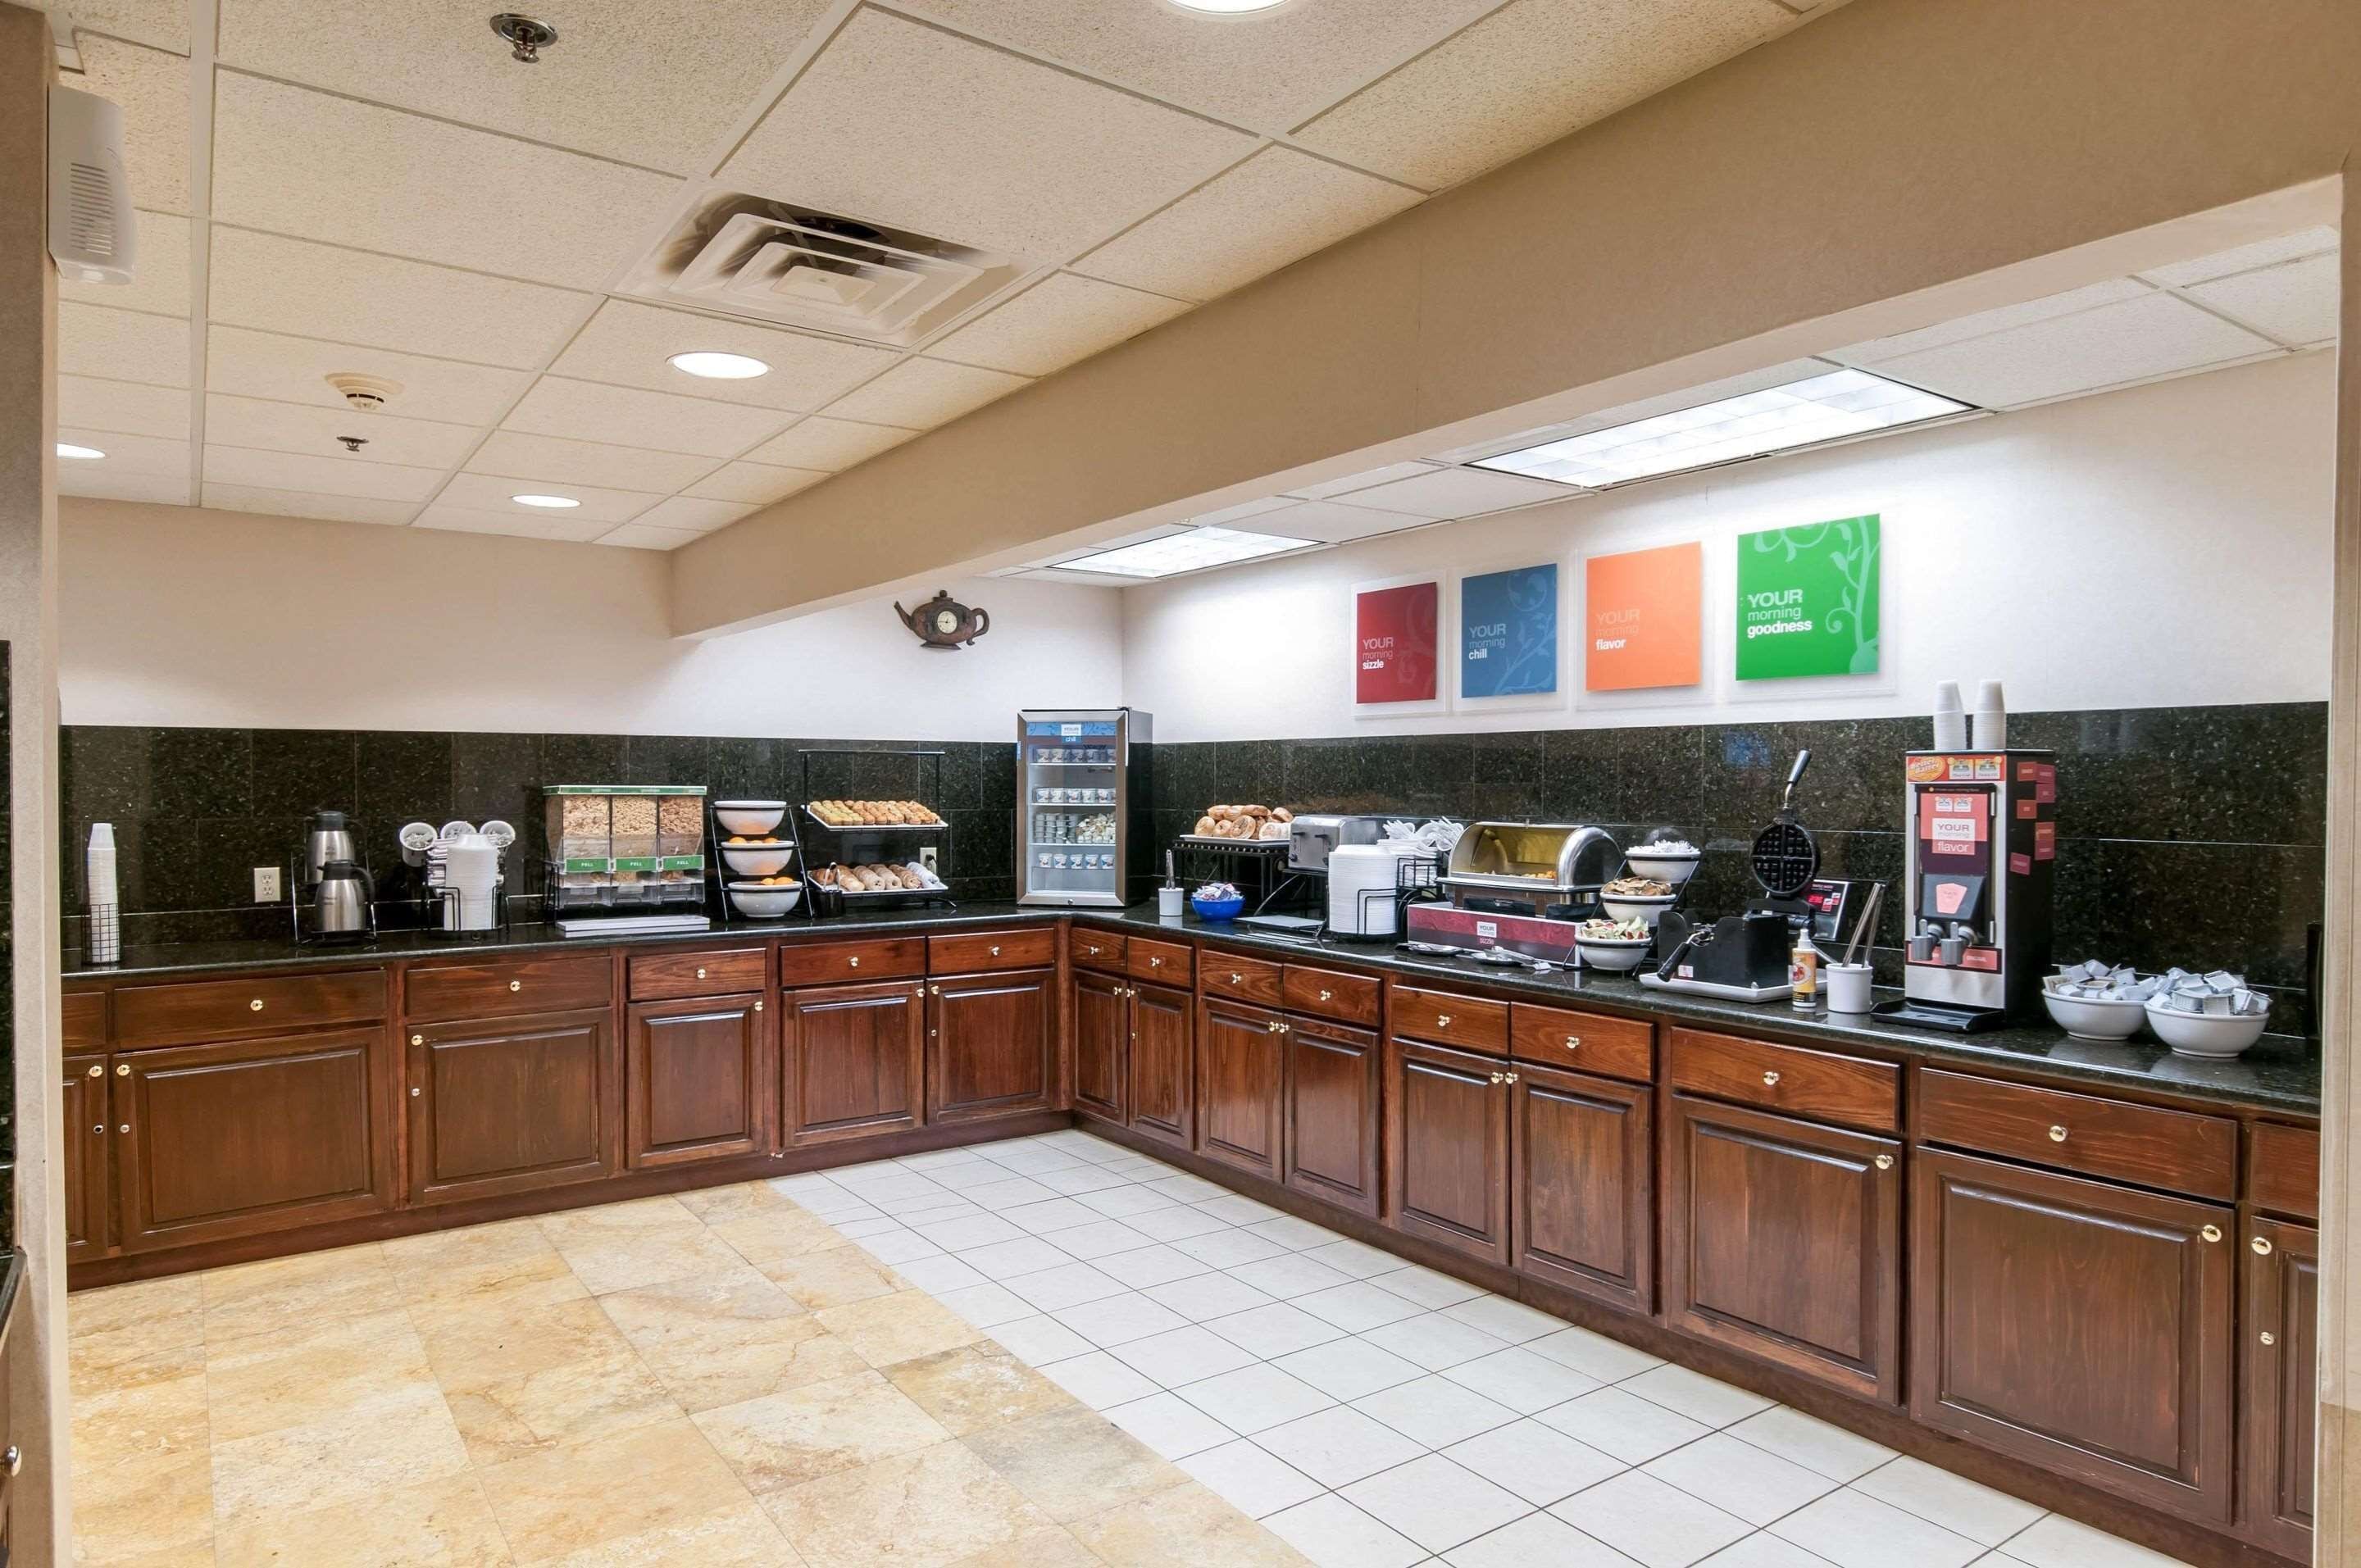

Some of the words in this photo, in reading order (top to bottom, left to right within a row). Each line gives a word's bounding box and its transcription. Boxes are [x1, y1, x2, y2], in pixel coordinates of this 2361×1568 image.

[1747, 589, 1803, 608] YOUR
[1596, 608, 1640, 625] YOUR
[1747, 606, 1802, 621] morning
[1468, 623, 1507, 639] YOUR
[1595, 623, 1640, 637] morning
[1747, 619, 1813, 639] goodness
[1362, 637, 1394, 650] YOUR
[1468, 636, 1506, 649] morning
[1595, 638, 1626, 651] flavor
[1362, 649, 1394, 660] morning
[1468, 648, 1488, 660] chill
[1362, 659, 1385, 670] sizzle
[1937, 823, 1970, 832] YOUR
[1937, 841, 1970, 852] flavor
